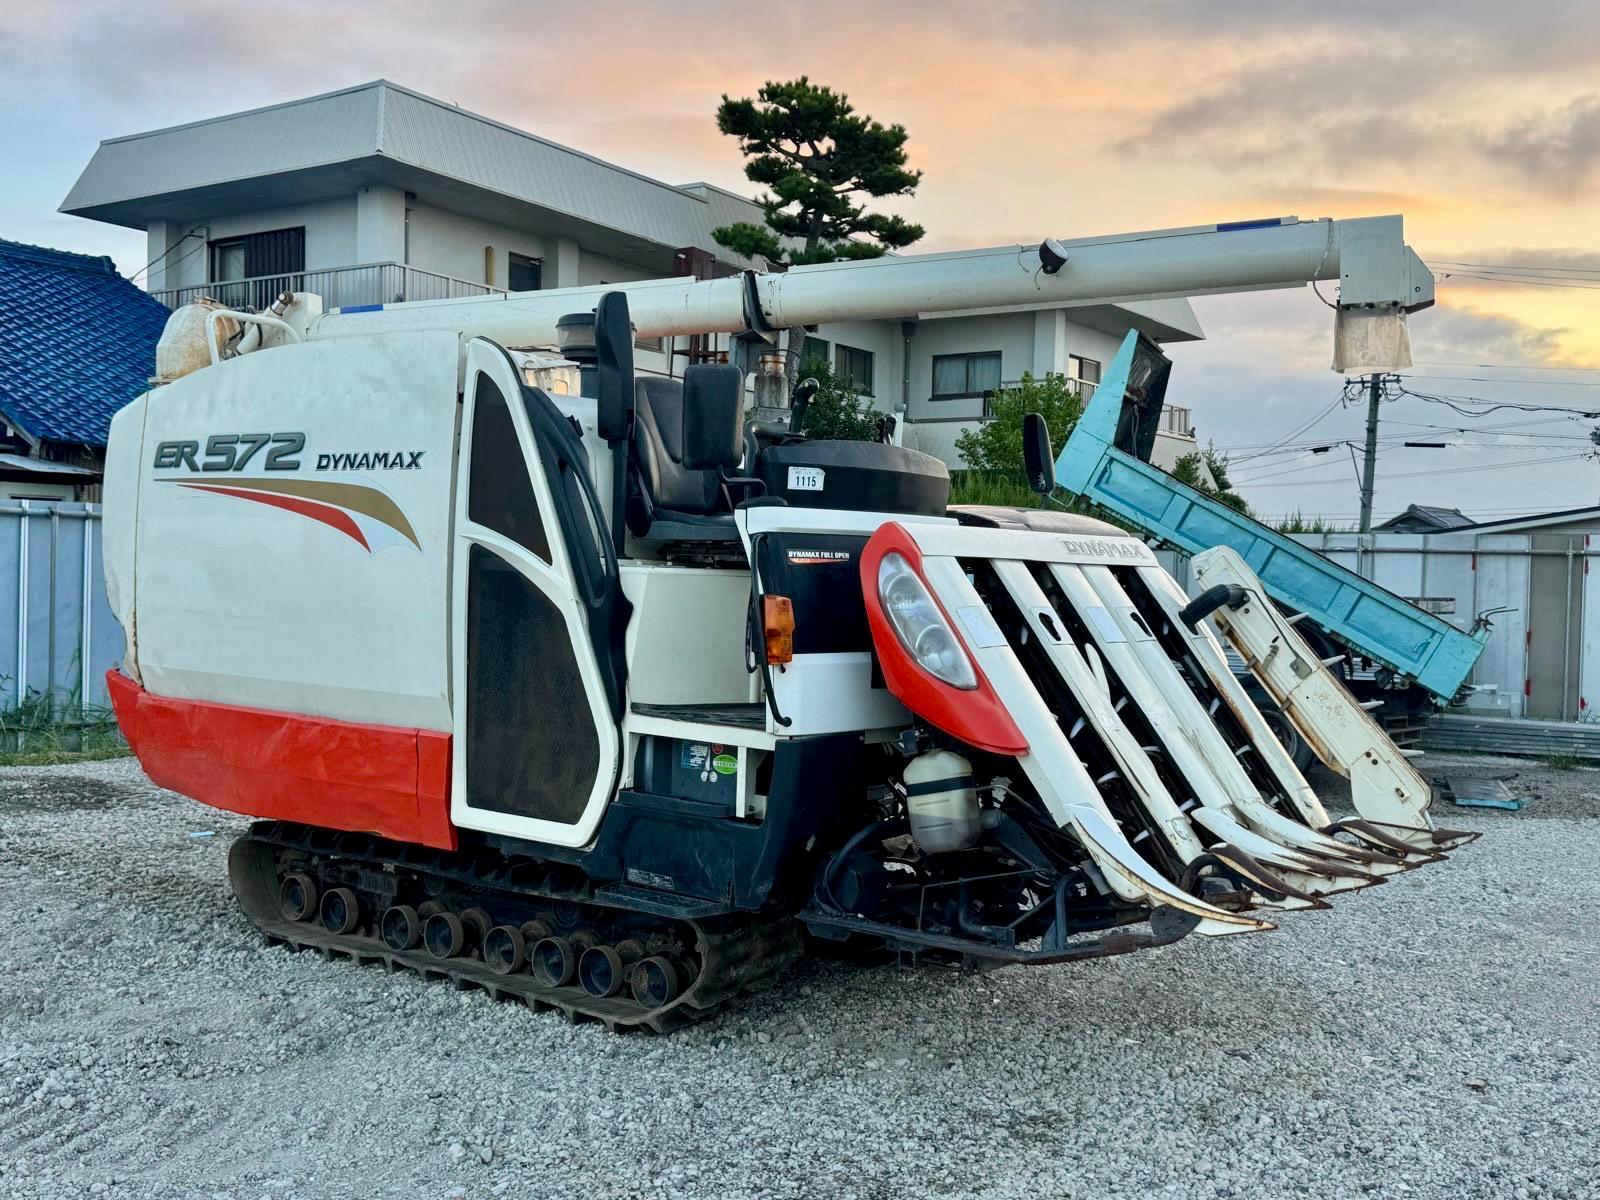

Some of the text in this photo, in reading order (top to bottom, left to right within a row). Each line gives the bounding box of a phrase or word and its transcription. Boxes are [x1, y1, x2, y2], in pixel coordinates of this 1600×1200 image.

[315, 450, 427, 472] DYNAMAX
[795, 475, 817, 488] 1115
[788, 550, 850, 560] DYNAMAX FULL OPEN
[1061, 540, 1147, 558] DYNAMAX
